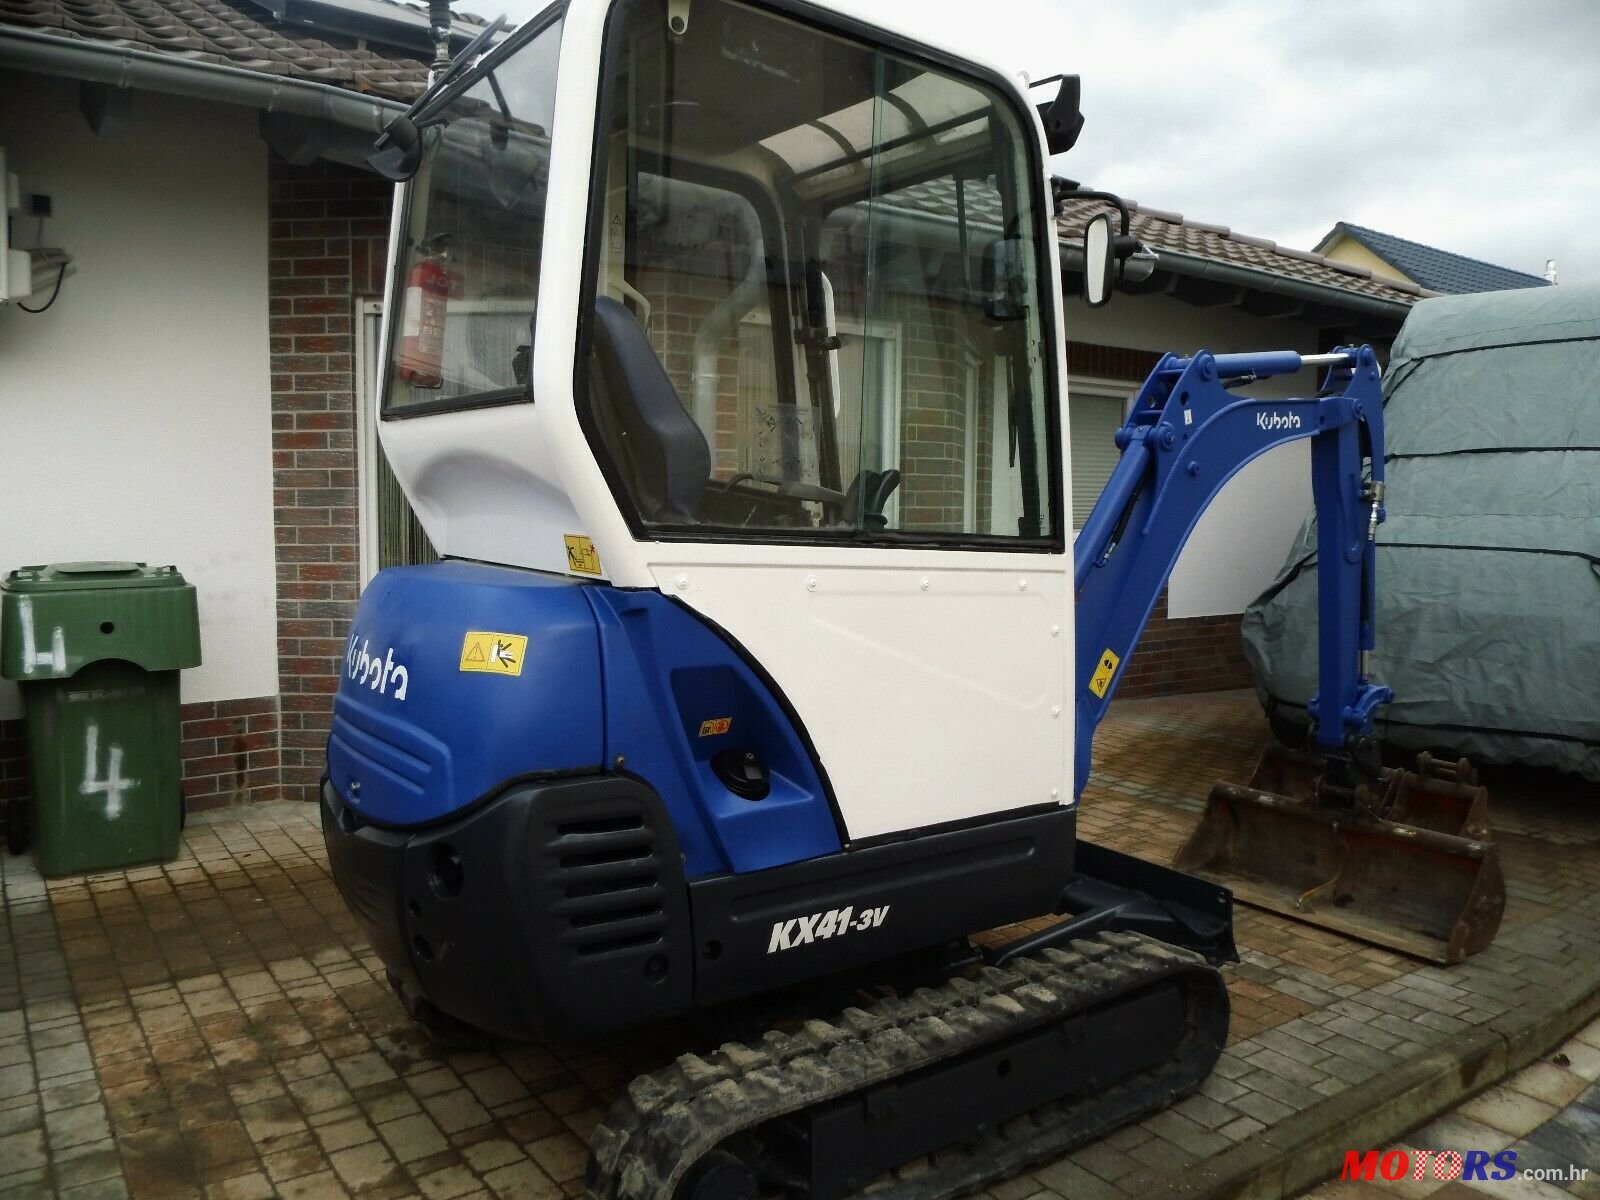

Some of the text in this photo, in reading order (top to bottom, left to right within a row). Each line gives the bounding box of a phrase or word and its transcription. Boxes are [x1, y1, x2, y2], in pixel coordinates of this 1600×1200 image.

[1256, 411, 1301, 430] Kubota
[346, 633, 409, 701] Kubota
[79, 720, 141, 820] 4
[767, 905, 891, 954] KX41-3V
